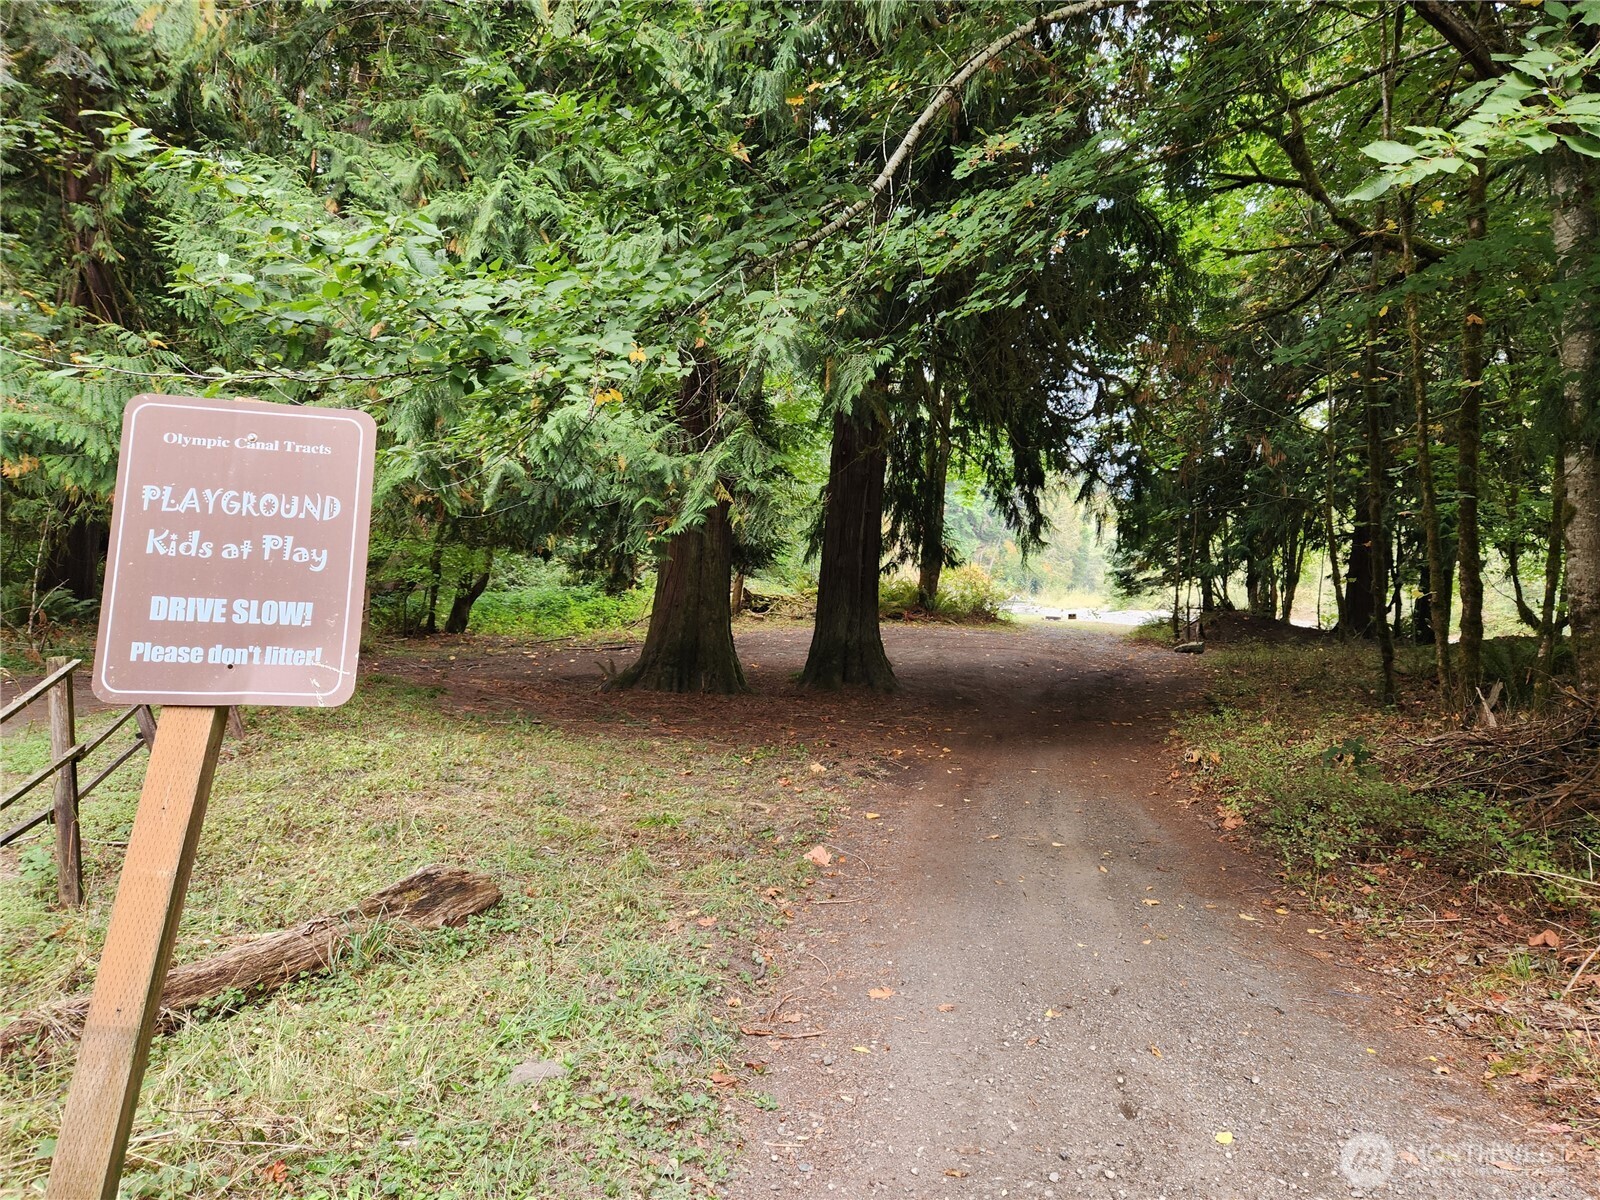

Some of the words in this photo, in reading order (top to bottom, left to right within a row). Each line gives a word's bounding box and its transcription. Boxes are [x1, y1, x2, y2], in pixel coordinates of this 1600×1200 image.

[163, 432, 231, 449] Olympic
[234, 437, 279, 451] Canal
[284, 441, 332, 455] Tracts
[142, 485, 341, 521] PLAYGROUND
[146, 529, 213, 558] Kids
[221, 540, 253, 560] at
[262, 534, 328, 572] Play
[149, 596, 227, 623] DRIVE
[232, 599, 314, 627] SLOW!
[129, 642, 204, 664] Please
[207, 645, 262, 666] don't
[264, 646, 323, 666] litter!
